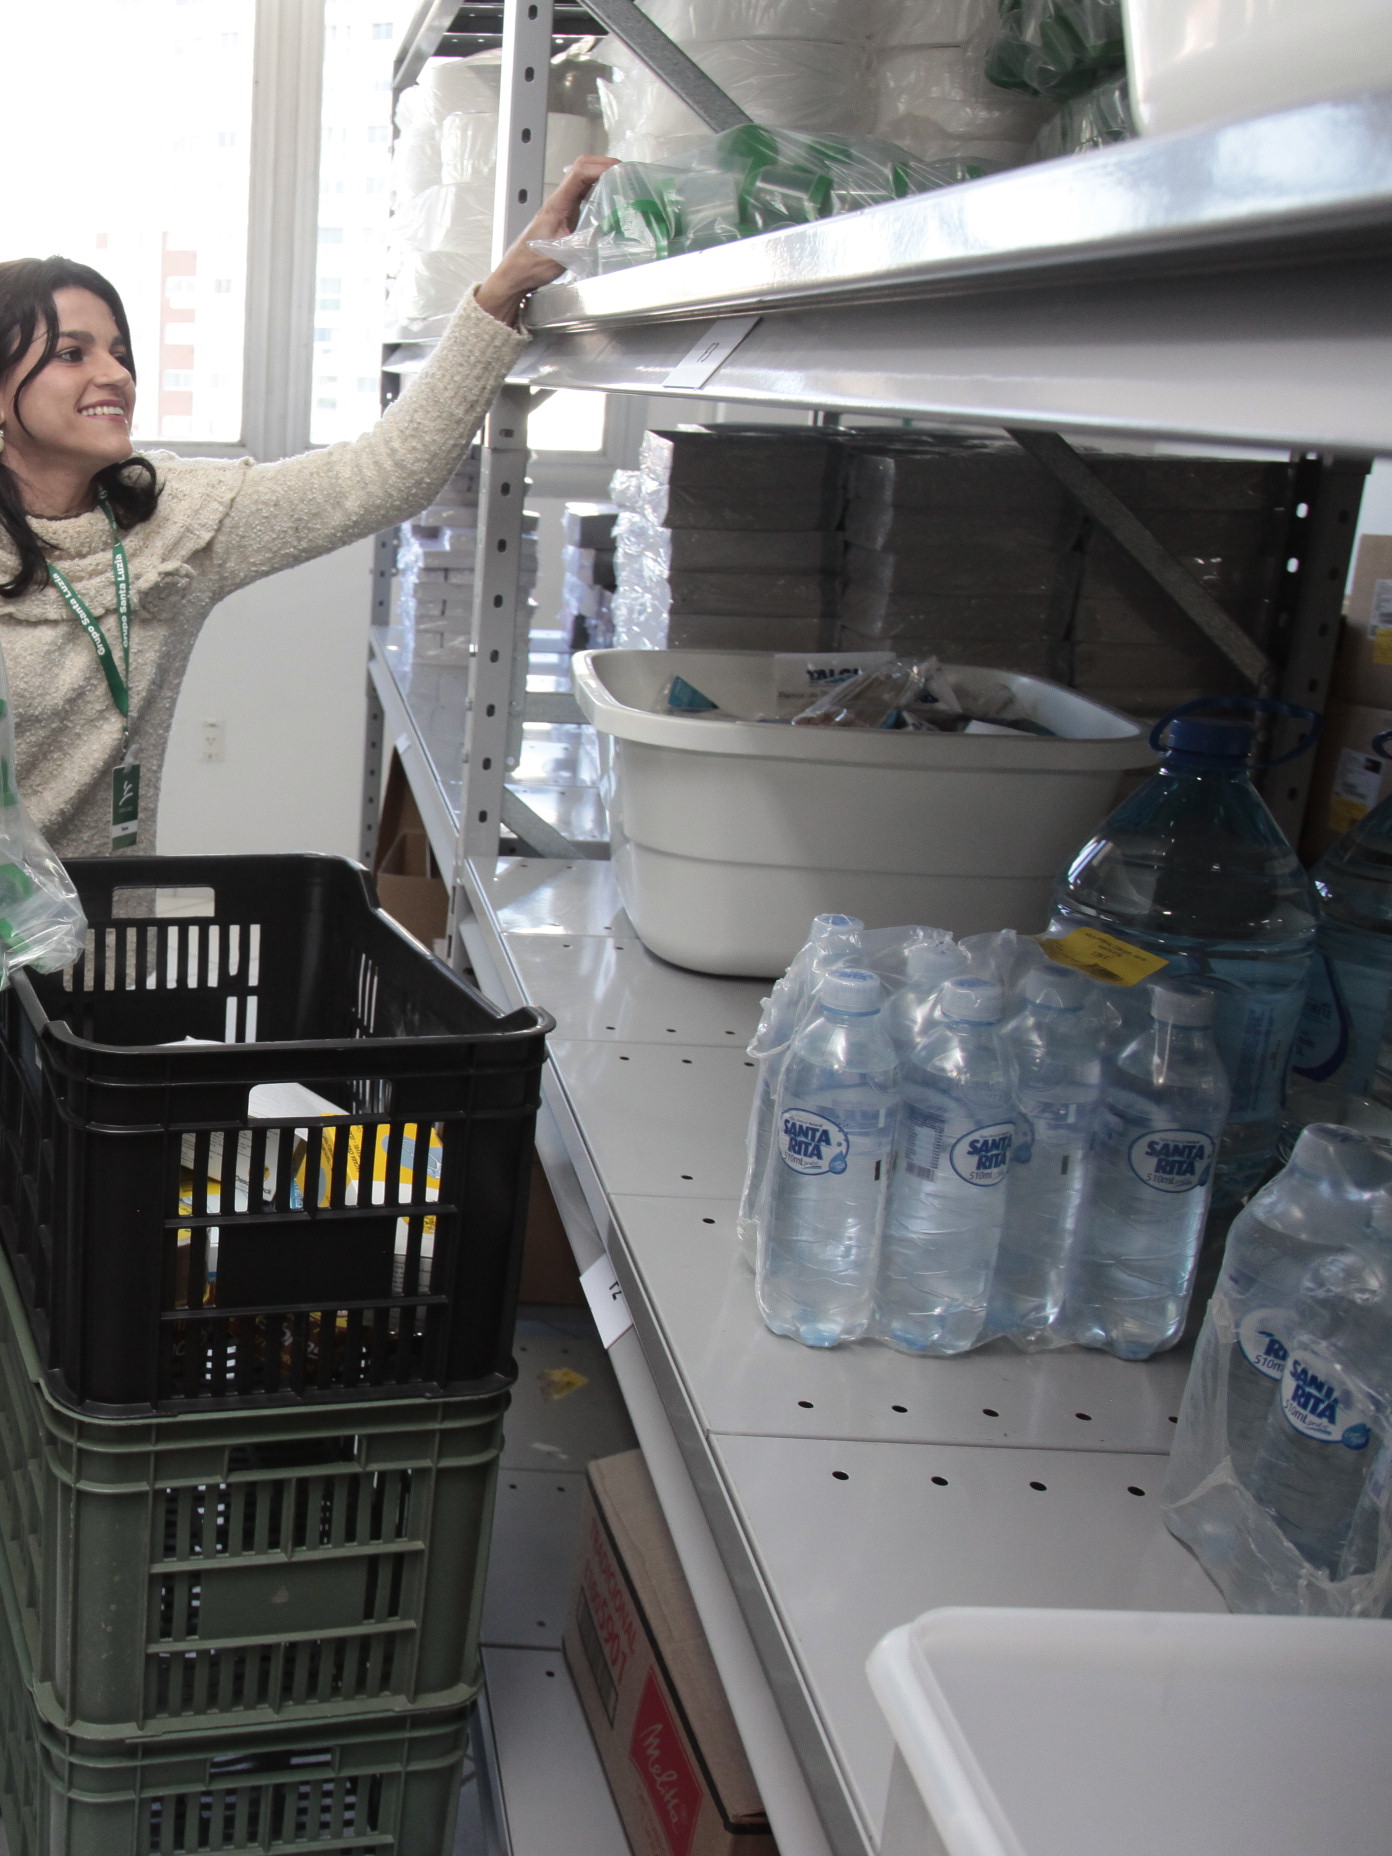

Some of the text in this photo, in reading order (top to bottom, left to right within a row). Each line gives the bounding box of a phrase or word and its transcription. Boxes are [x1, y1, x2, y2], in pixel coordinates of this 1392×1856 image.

[115, 553, 126, 581] Luzia
[119, 583, 127, 613] Santa
[52, 573, 106, 656] Grupo Santa Luzia
[783, 1118, 832, 1147] SANTA
[788, 1136, 824, 1161] RITA
[1145, 1140, 1205, 1161] SANTA
[1154, 1158, 1196, 1176] RITA
[1291, 1383, 1337, 1426] RITA
